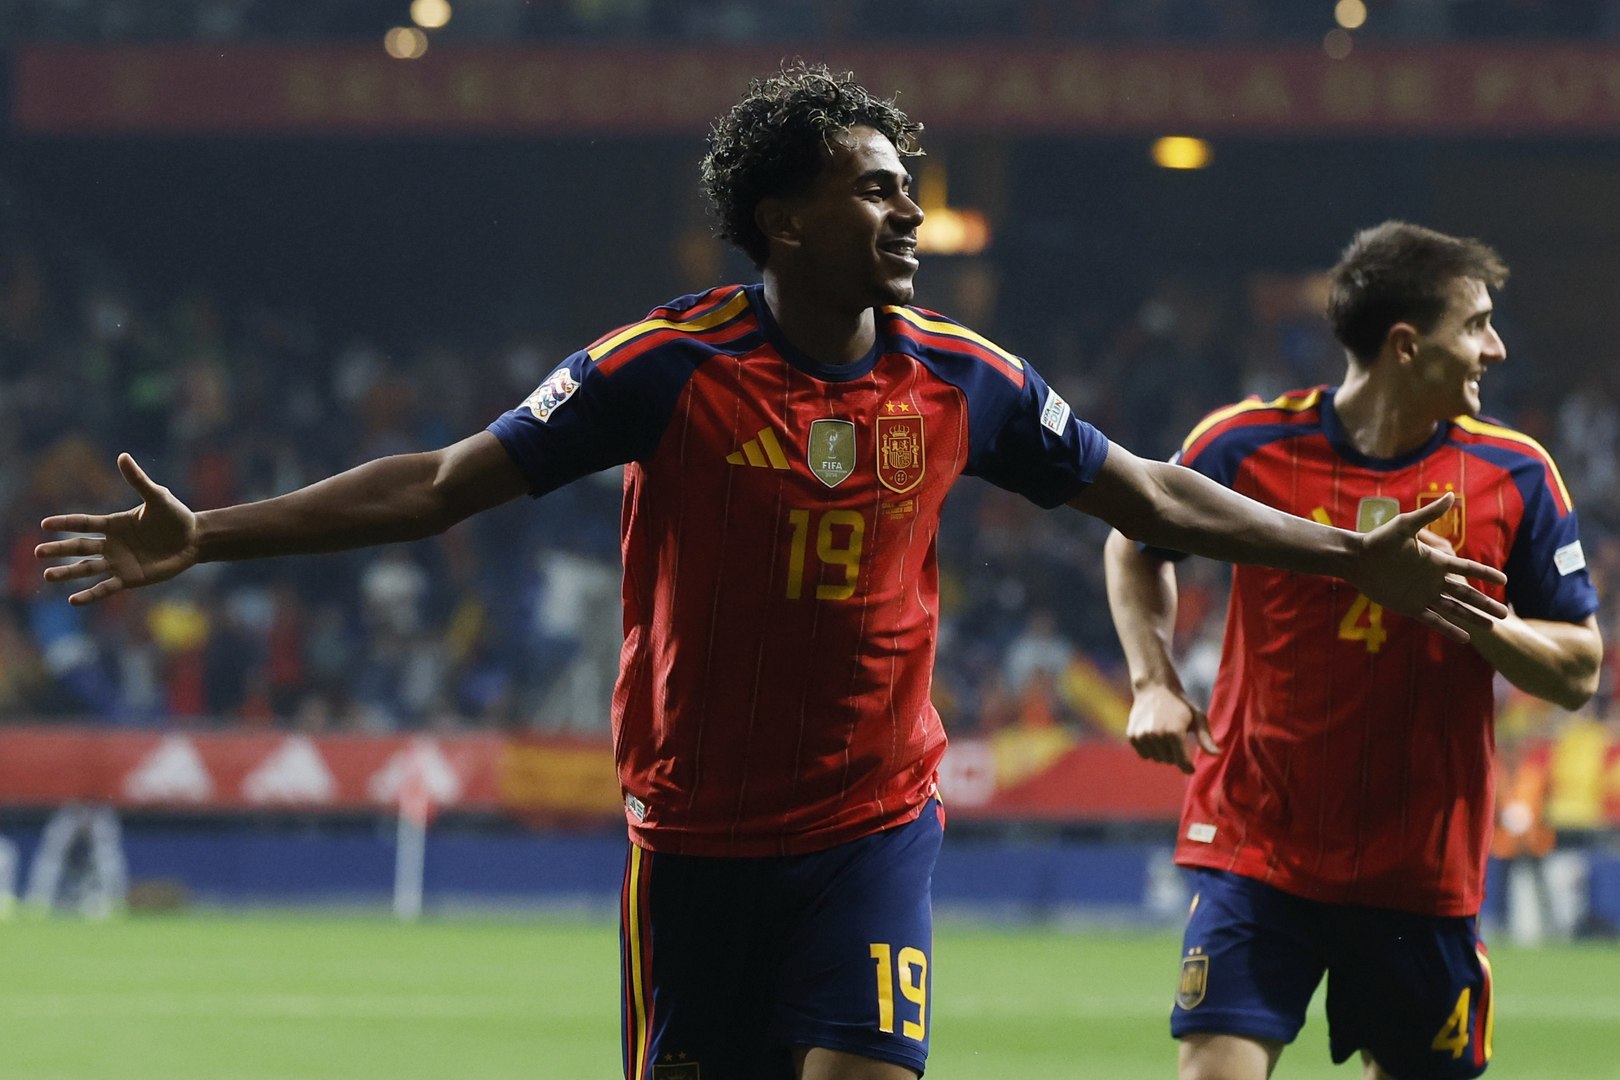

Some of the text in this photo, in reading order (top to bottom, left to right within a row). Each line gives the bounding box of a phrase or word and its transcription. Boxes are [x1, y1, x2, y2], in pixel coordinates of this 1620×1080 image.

[822, 461, 843, 470] FIFA
[785, 509, 865, 600] 19
[1338, 593, 1387, 653] 4
[869, 943, 927, 1042] 19
[1432, 987, 1471, 1059] 4
